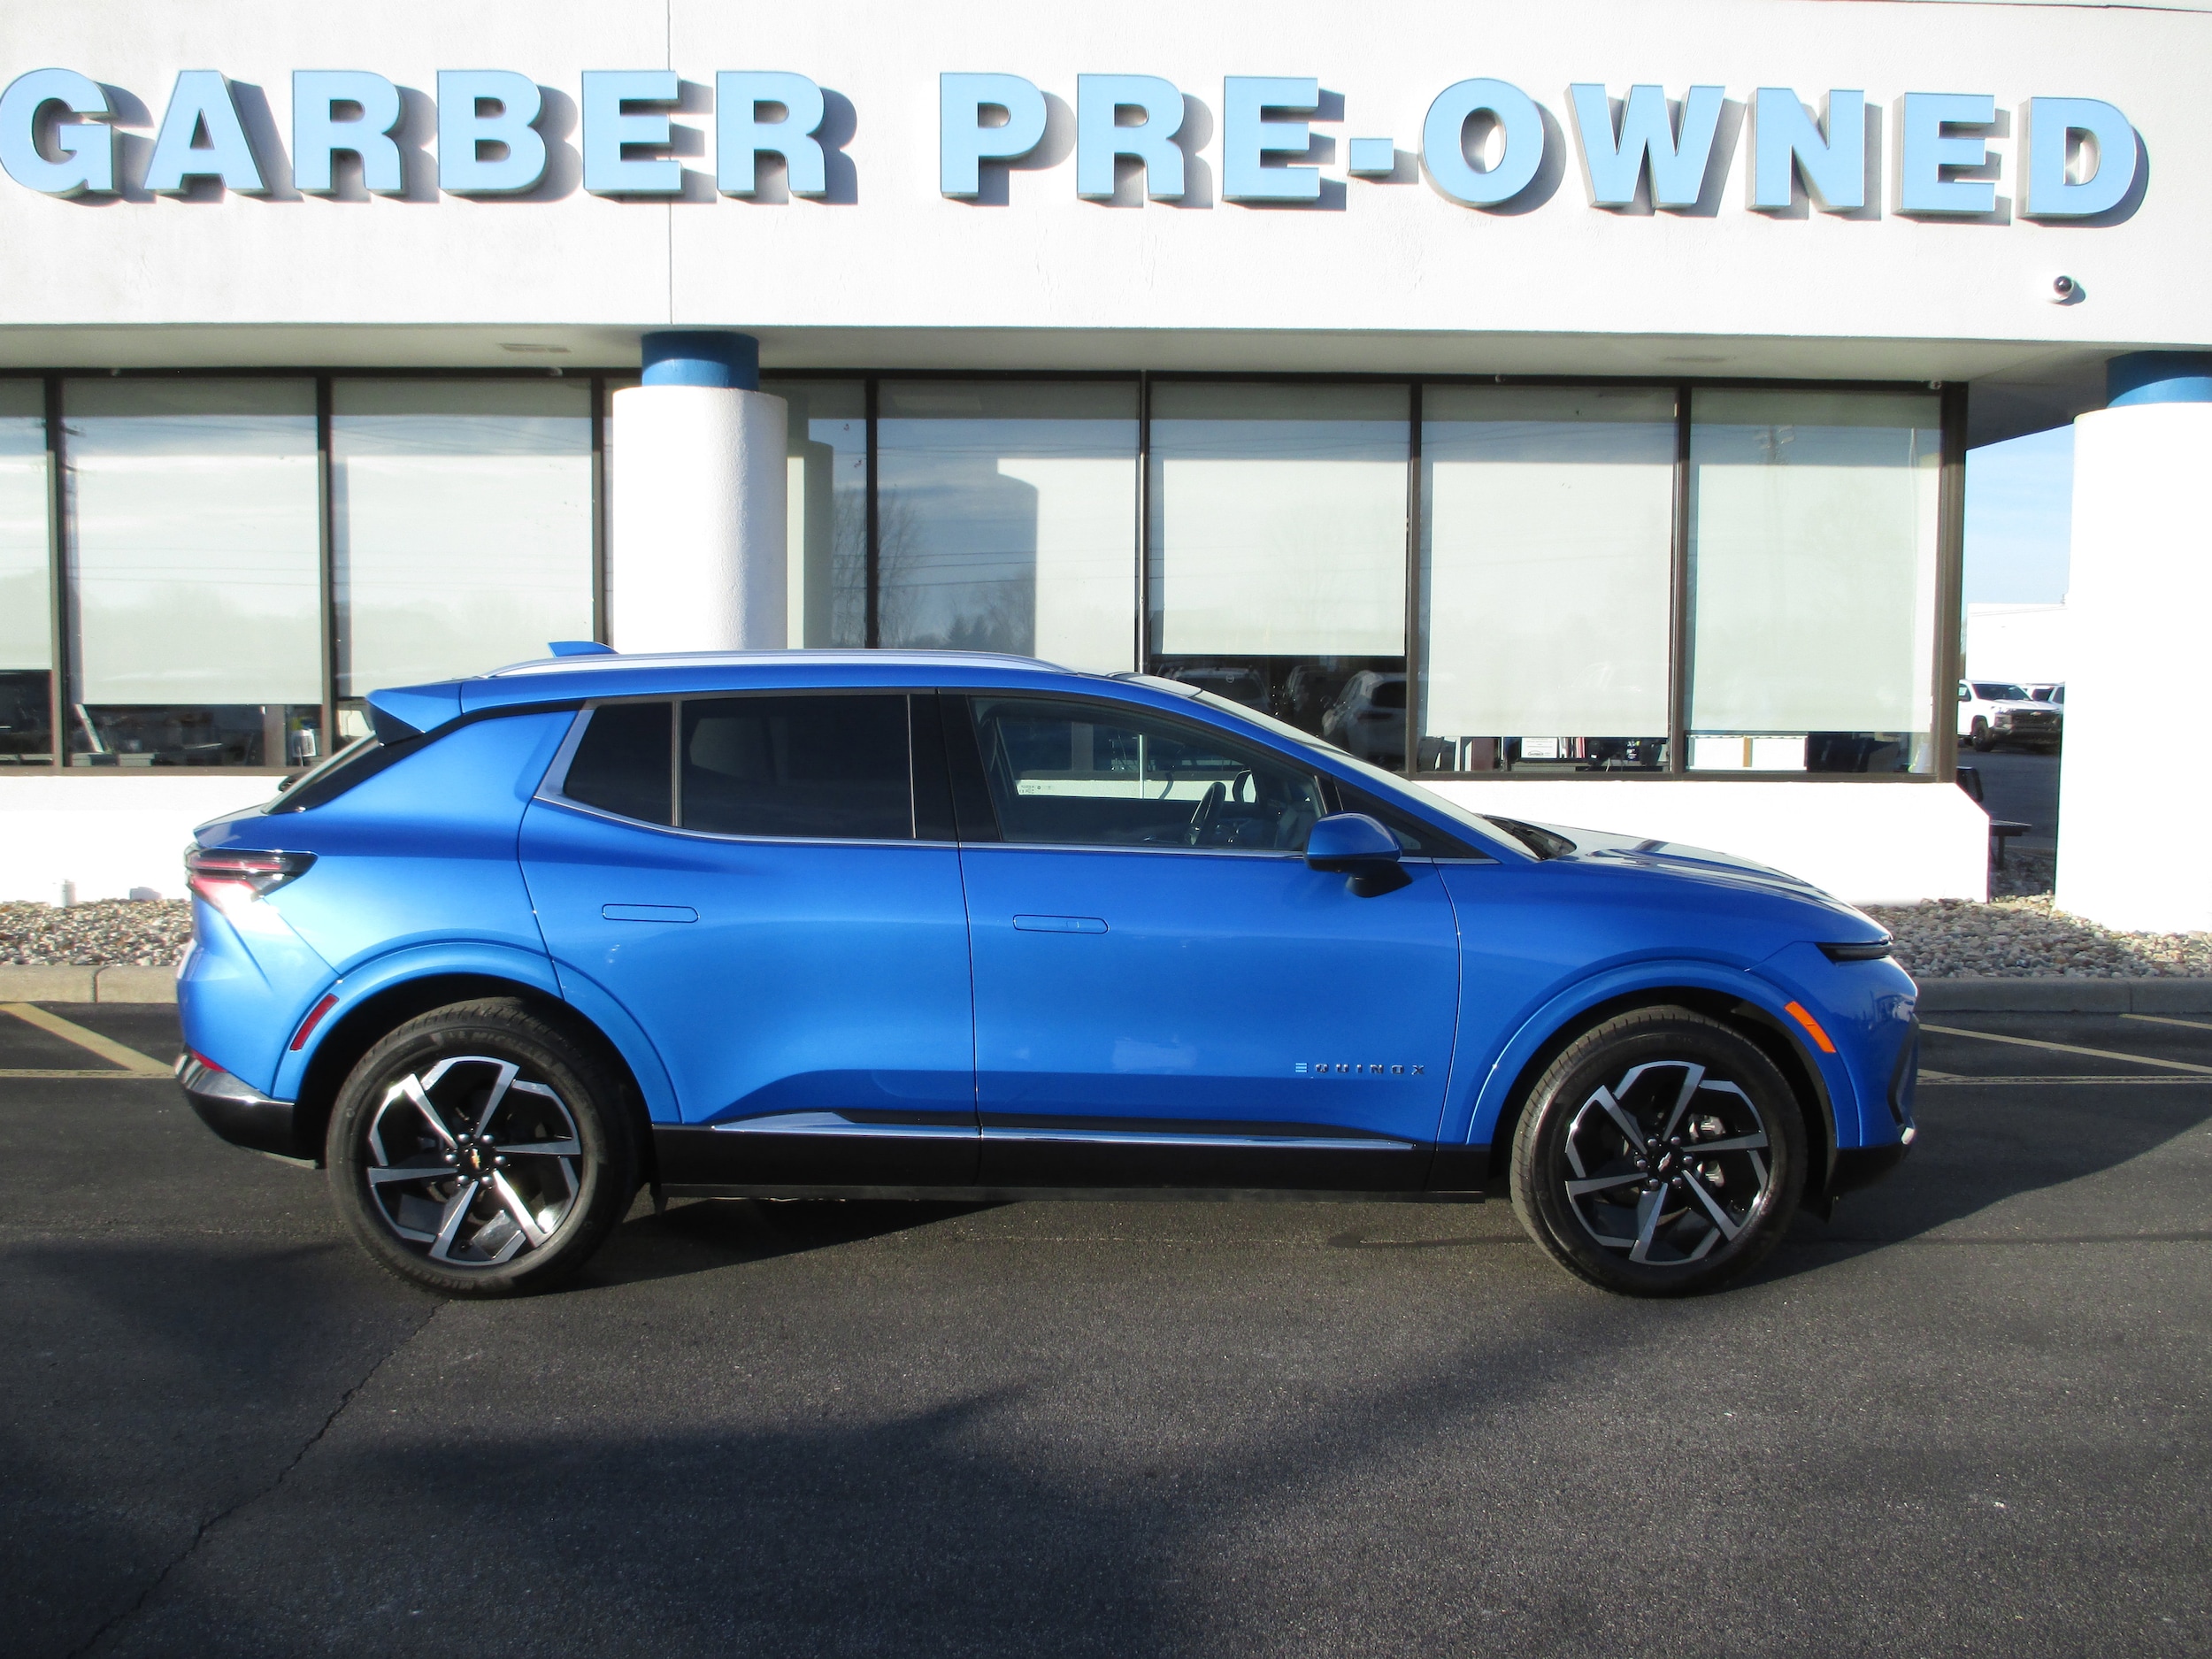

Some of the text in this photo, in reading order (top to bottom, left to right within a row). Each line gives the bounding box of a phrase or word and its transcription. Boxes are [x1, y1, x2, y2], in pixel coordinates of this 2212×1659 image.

[0, 67, 2139, 218] GARBER PRE-OWNED
[1294, 1062, 1425, 1075] EQUINOX
